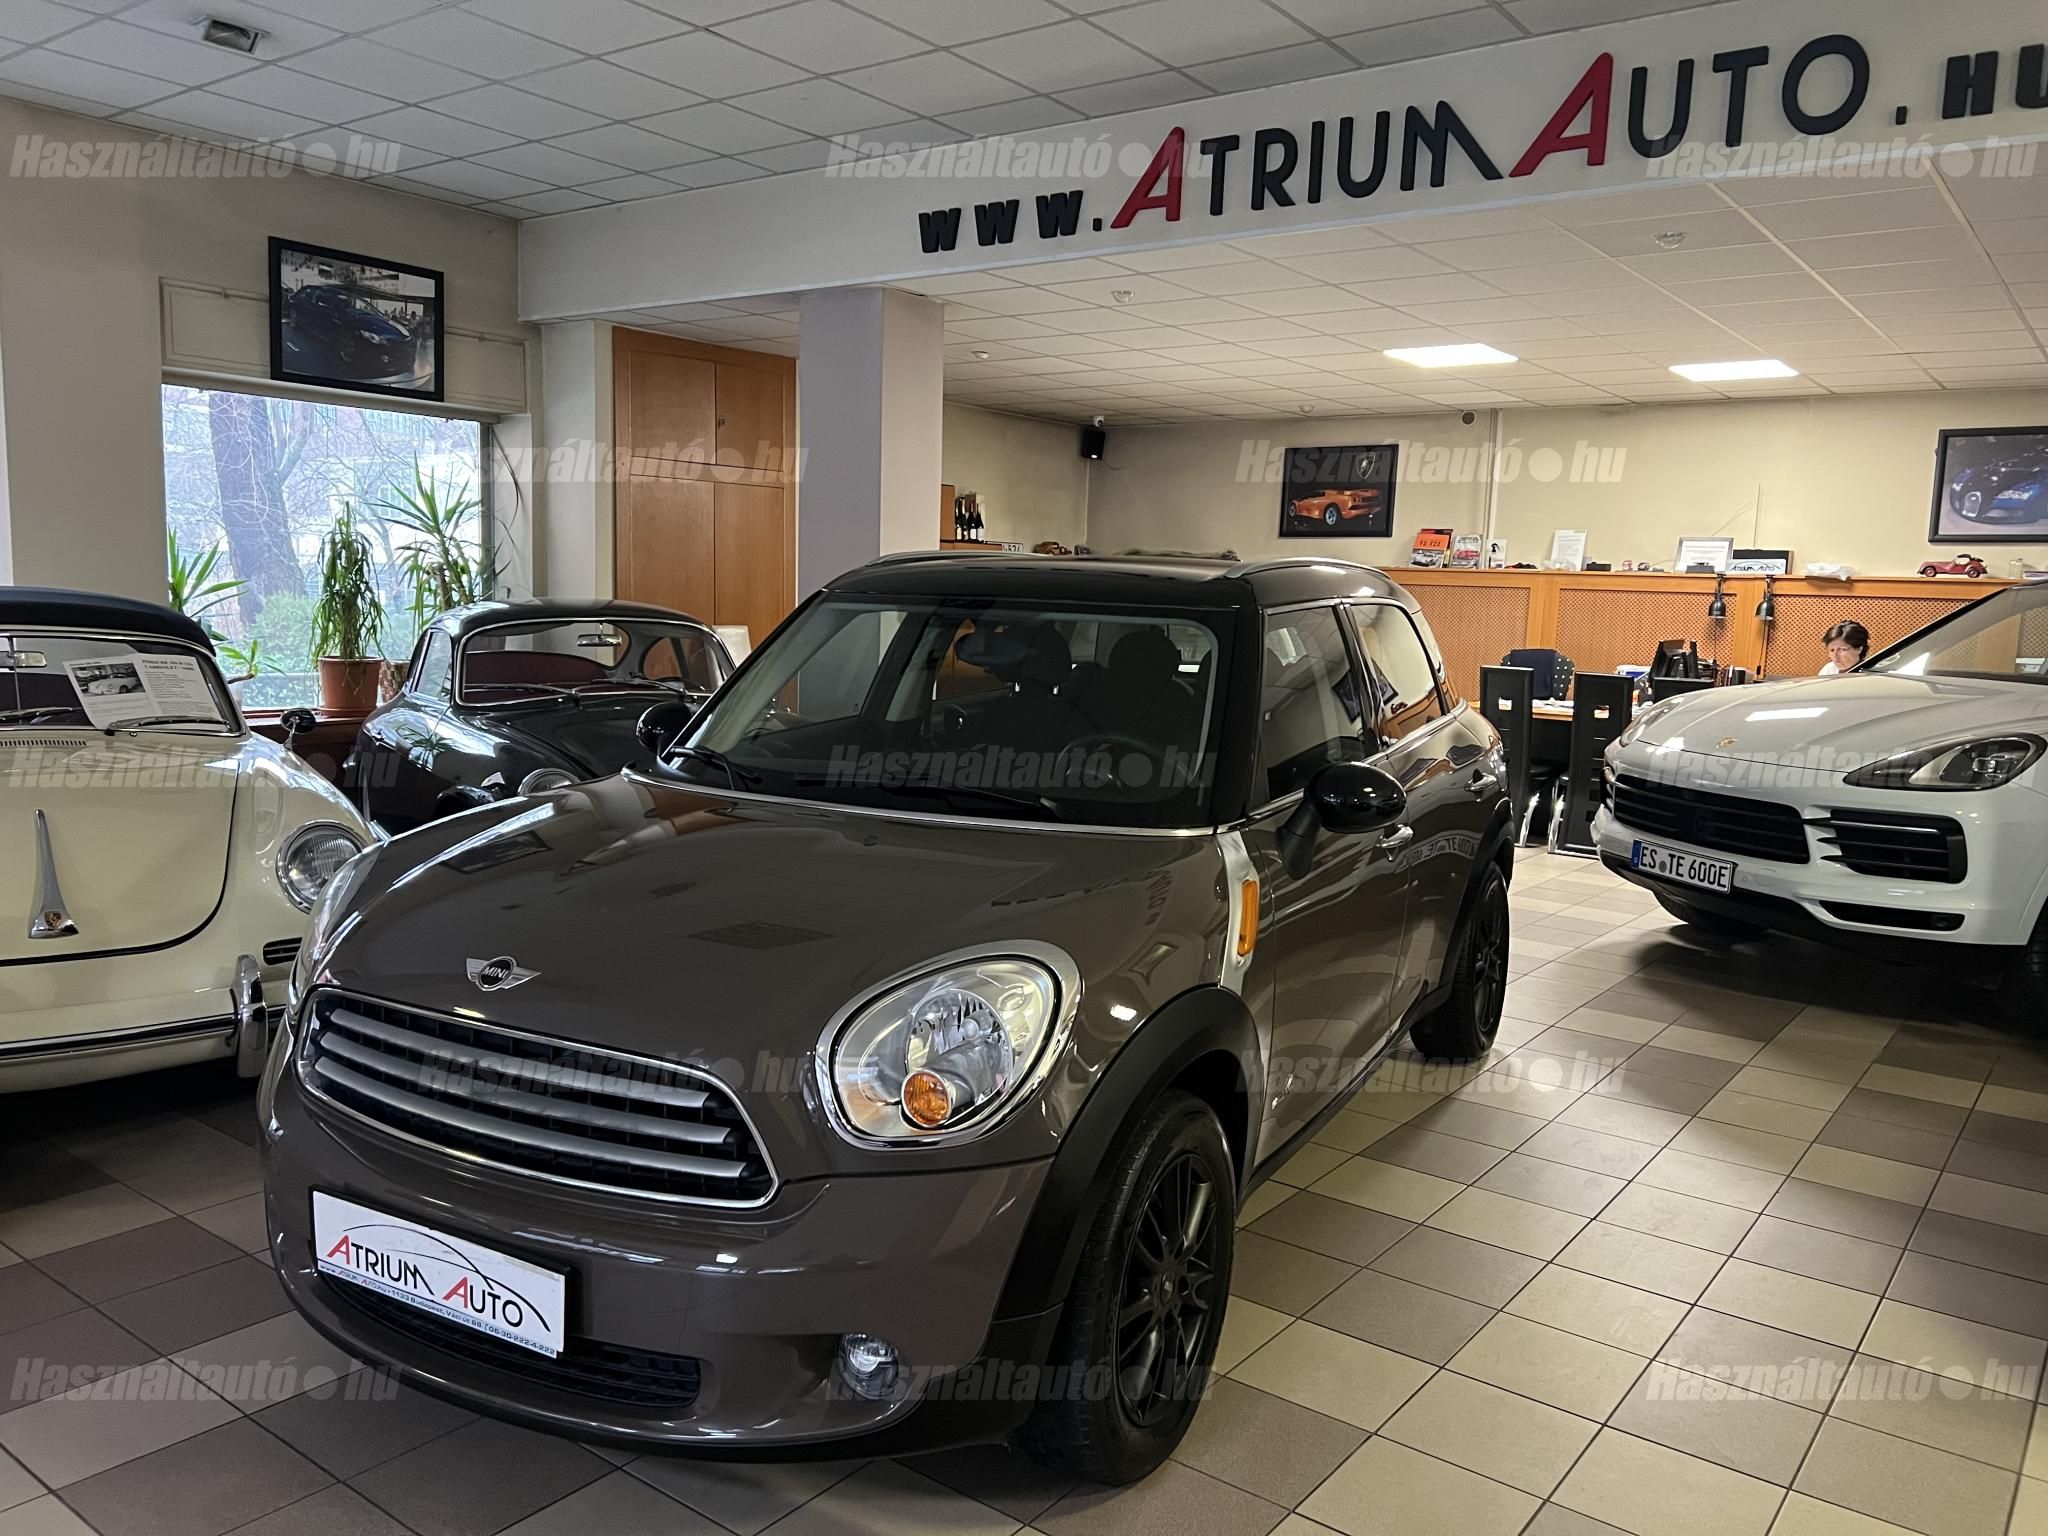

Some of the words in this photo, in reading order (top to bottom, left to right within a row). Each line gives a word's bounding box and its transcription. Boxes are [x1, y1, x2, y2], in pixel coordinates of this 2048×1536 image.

[1640, 846, 1657, 869] ES
[1668, 853, 1685, 877] TE
[1688, 859, 1728, 889] 600E
[482, 966, 510, 979] MINI
[327, 1235, 435, 1296] ATRIUM
[443, 1276, 523, 1328] AUTO
